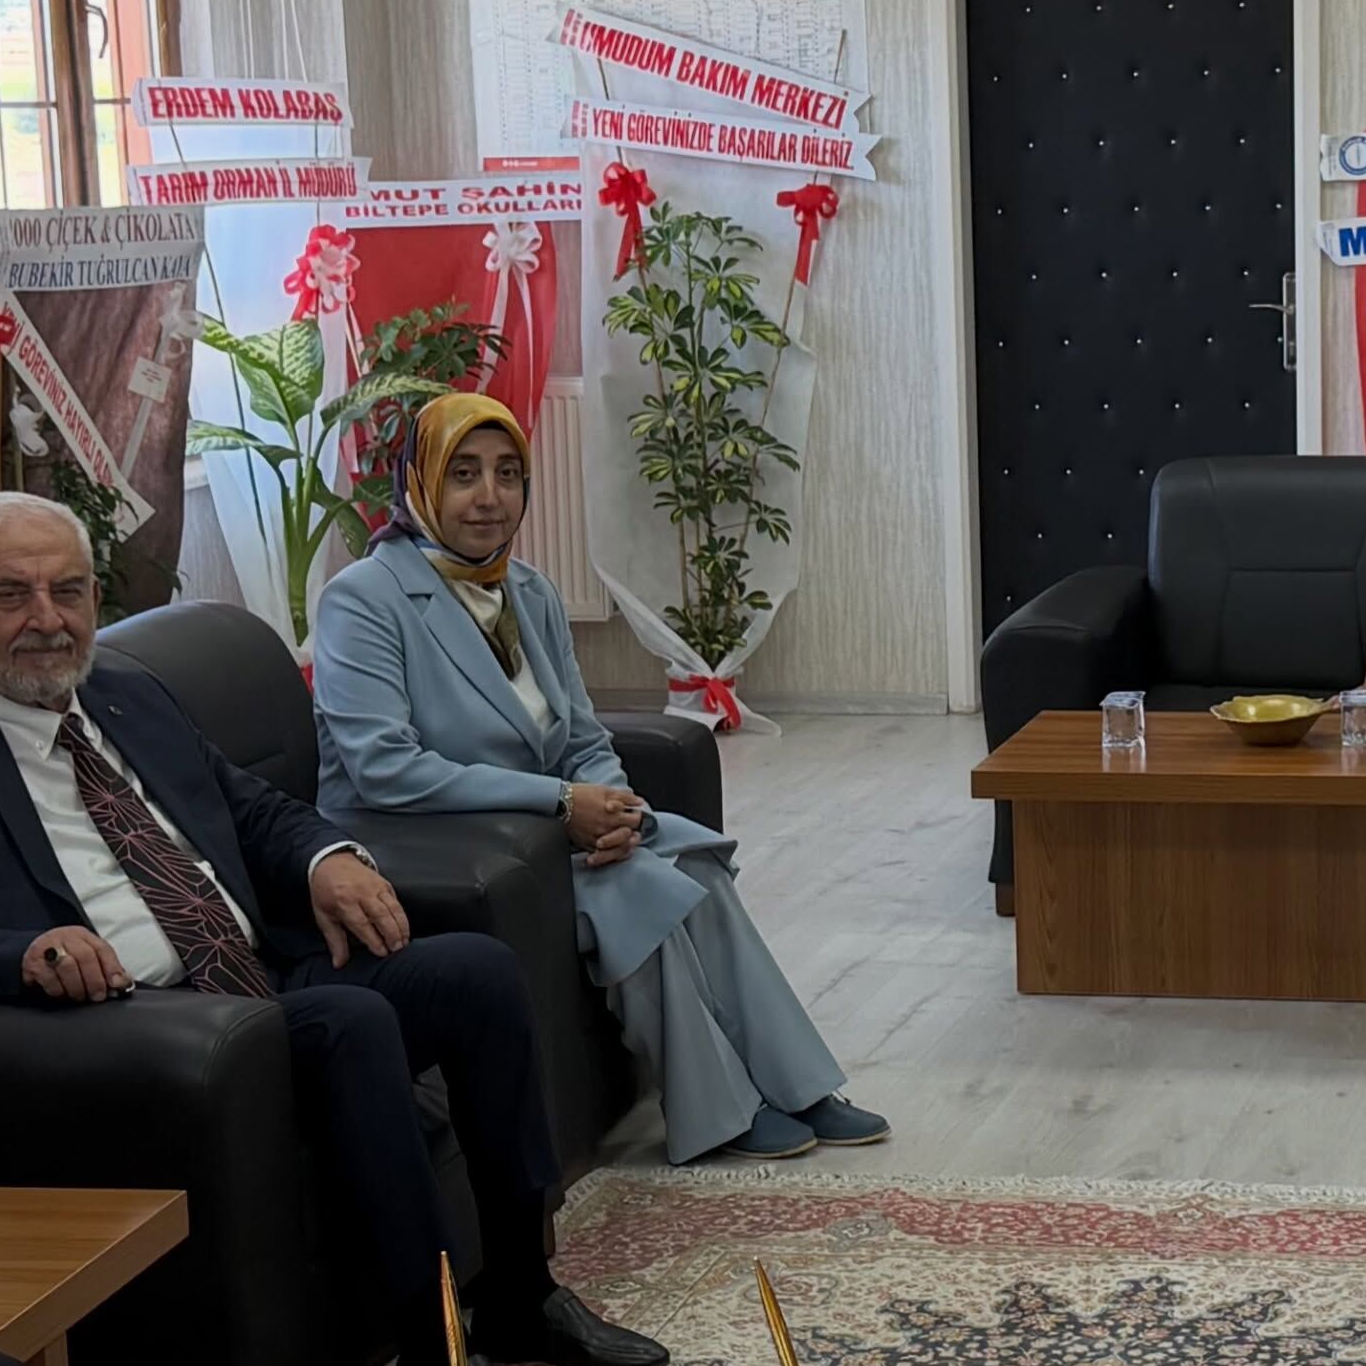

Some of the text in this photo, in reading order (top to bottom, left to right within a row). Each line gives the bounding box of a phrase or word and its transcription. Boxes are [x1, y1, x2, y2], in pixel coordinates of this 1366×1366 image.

[148, 86, 235, 120] ERDEM
[676, 50, 752, 101] BAKIM
[750, 72, 849, 131] MERKEZİ
[592, 103, 623, 140] YENİ
[627, 108, 715, 152] GÖREVİNİZDE
[718, 124, 797, 163] BAŞARILAR
[139, 159, 357, 205] TARIM ORMAN İL MÜDÜRÜ
[46, 210, 98, 253] ÇİÇEK
[114, 208, 196, 251] ÇİKOLATA
[345, 198, 582, 218] BİLTEPE OKULLARI
[18, 334, 68, 417] GÖREVİNİZ
[63, 400, 100, 460] HAYIRLI
